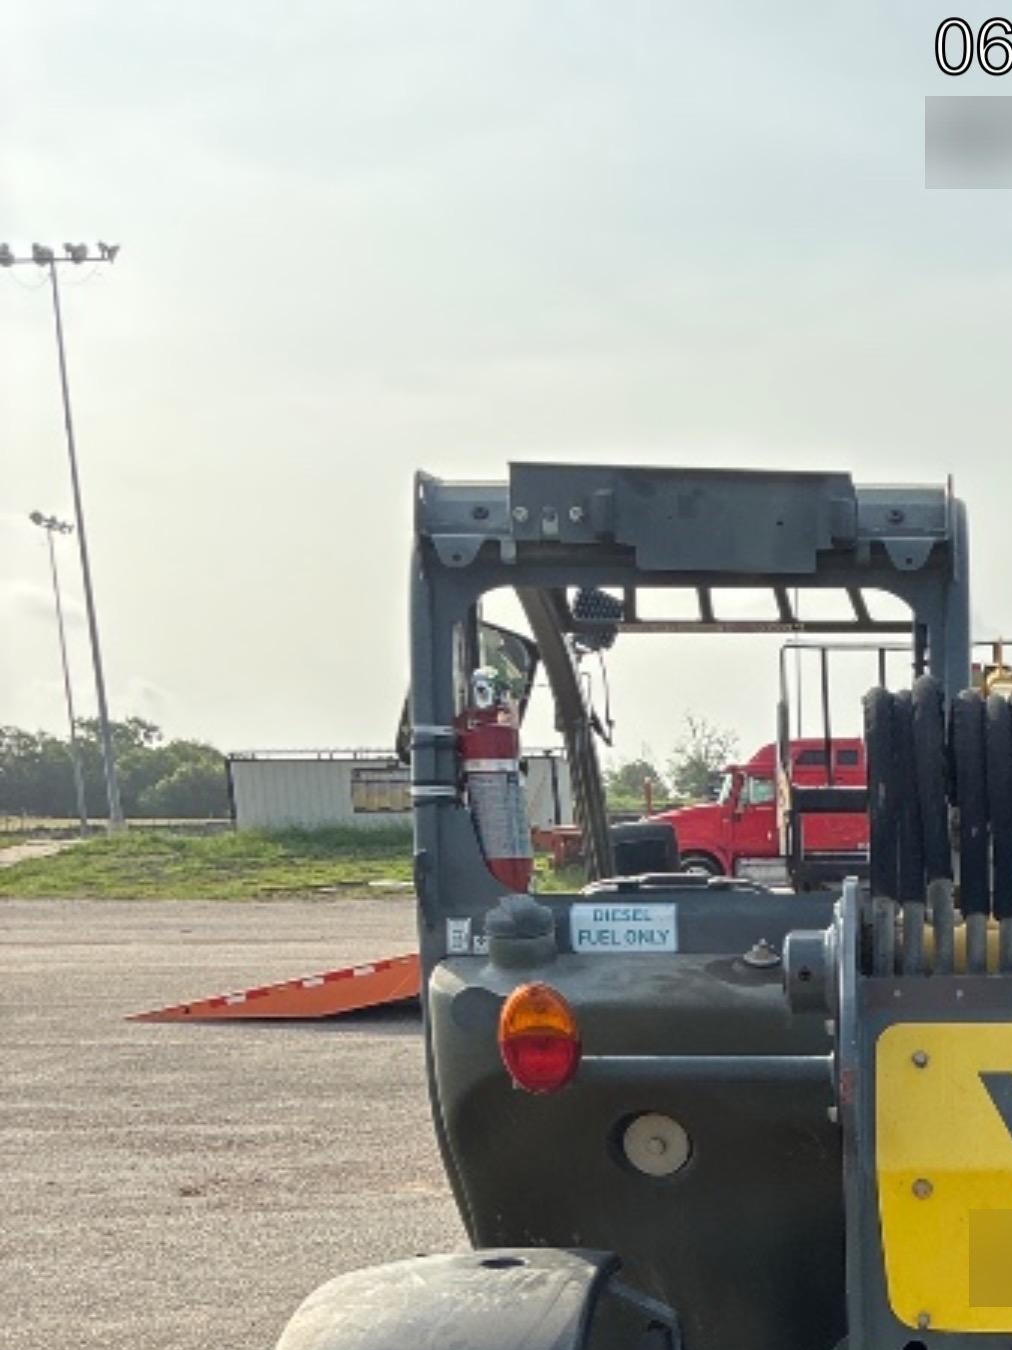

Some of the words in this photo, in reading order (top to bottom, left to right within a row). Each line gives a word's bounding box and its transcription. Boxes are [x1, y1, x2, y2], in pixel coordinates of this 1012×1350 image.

[592, 908, 652, 922] DIESEL
[577, 929, 622, 946] FUEL
[624, 929, 670, 946] ONLY
